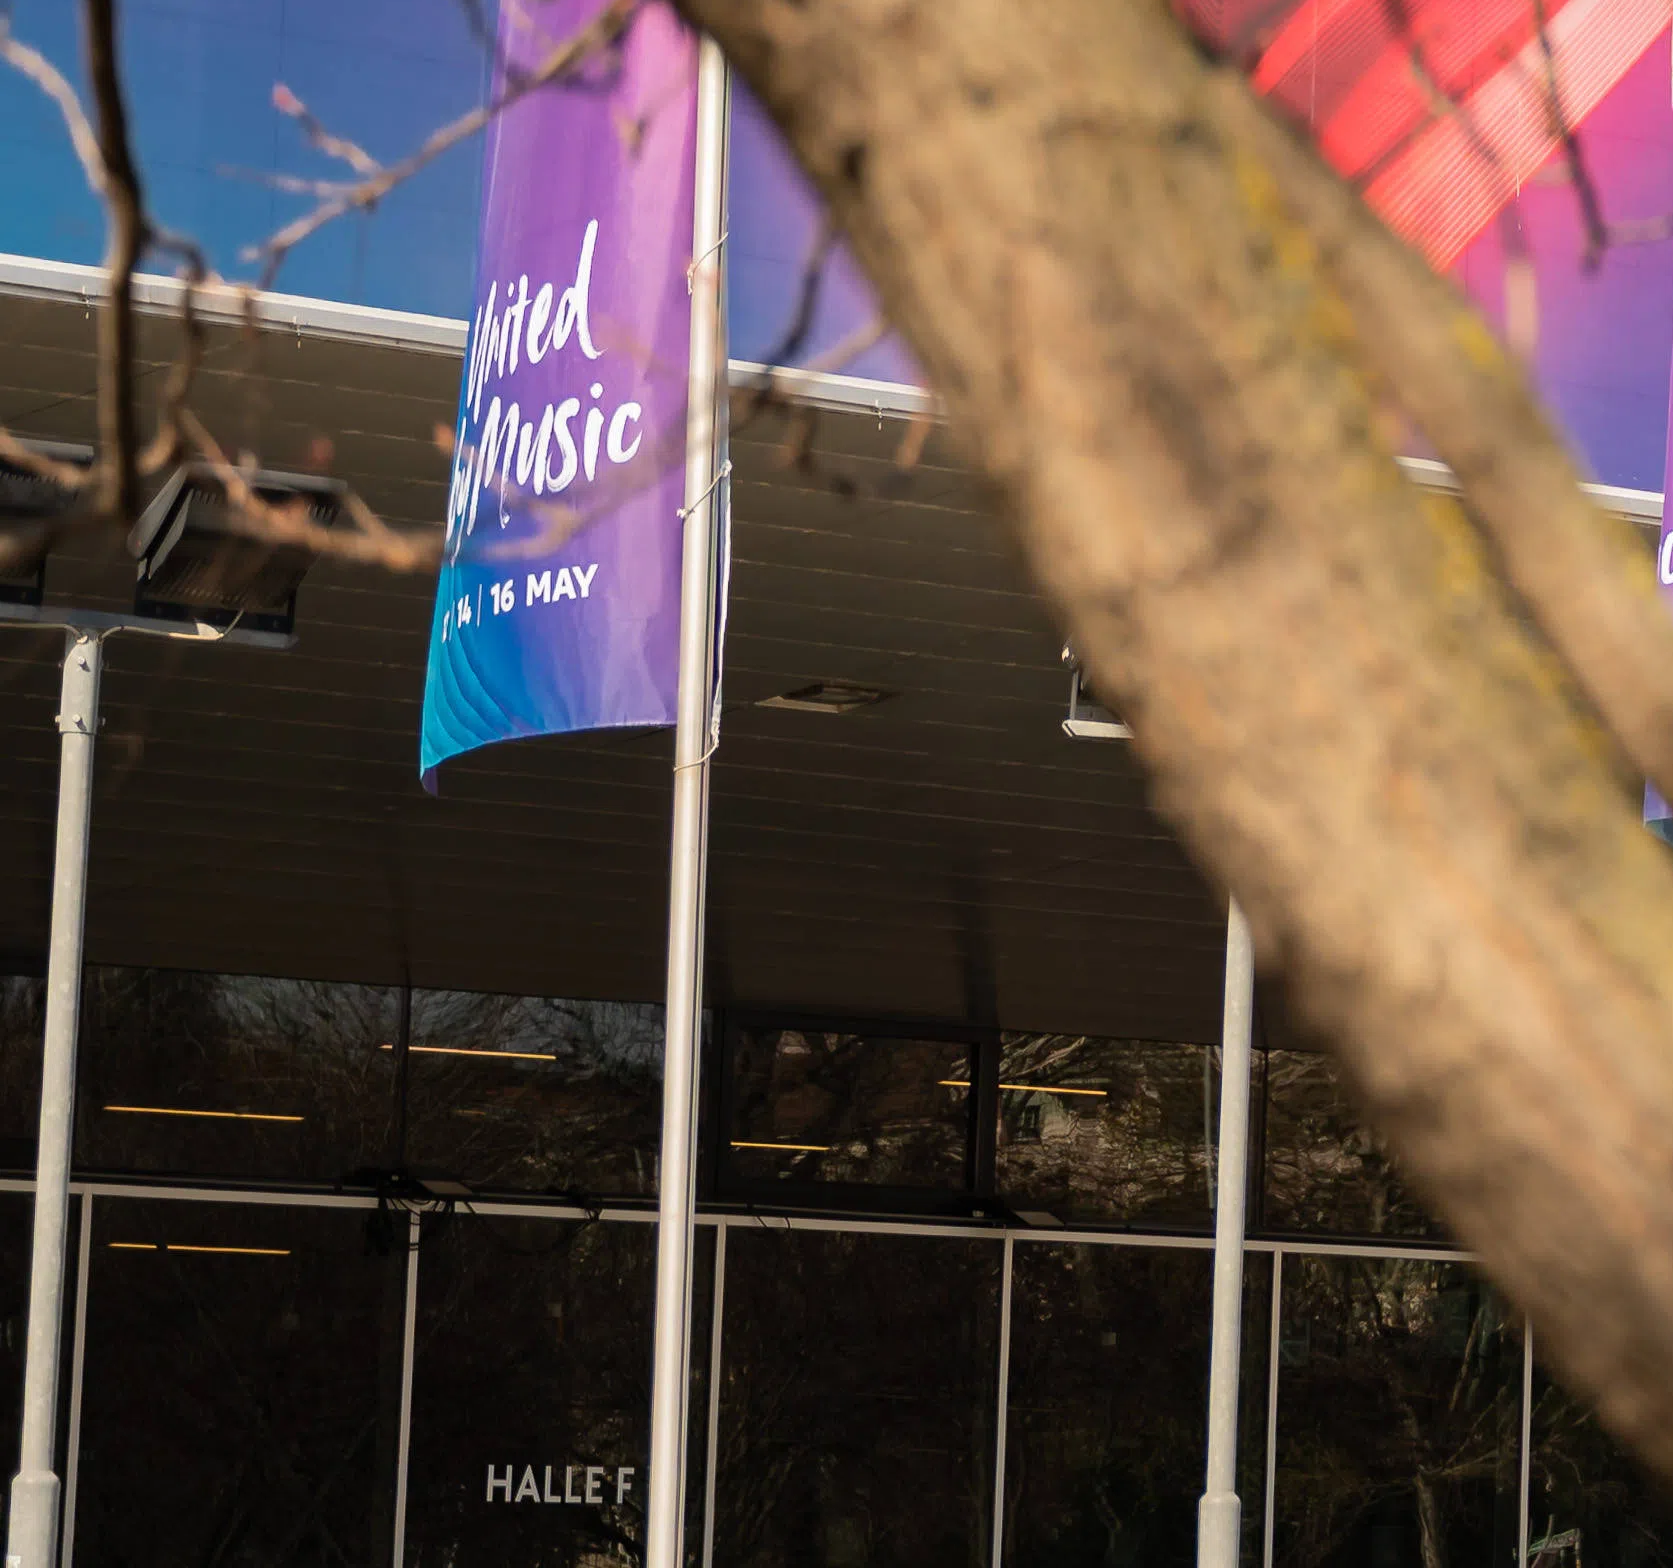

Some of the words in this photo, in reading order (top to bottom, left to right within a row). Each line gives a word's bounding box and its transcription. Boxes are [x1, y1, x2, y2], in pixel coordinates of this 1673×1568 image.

[467, 218, 607, 424] United
[466, 382, 642, 536] Music
[490, 579, 515, 616] 16
[526, 564, 599, 607] MAY
[486, 1464, 604, 1504] HALLE
[616, 1466, 635, 1505] F
